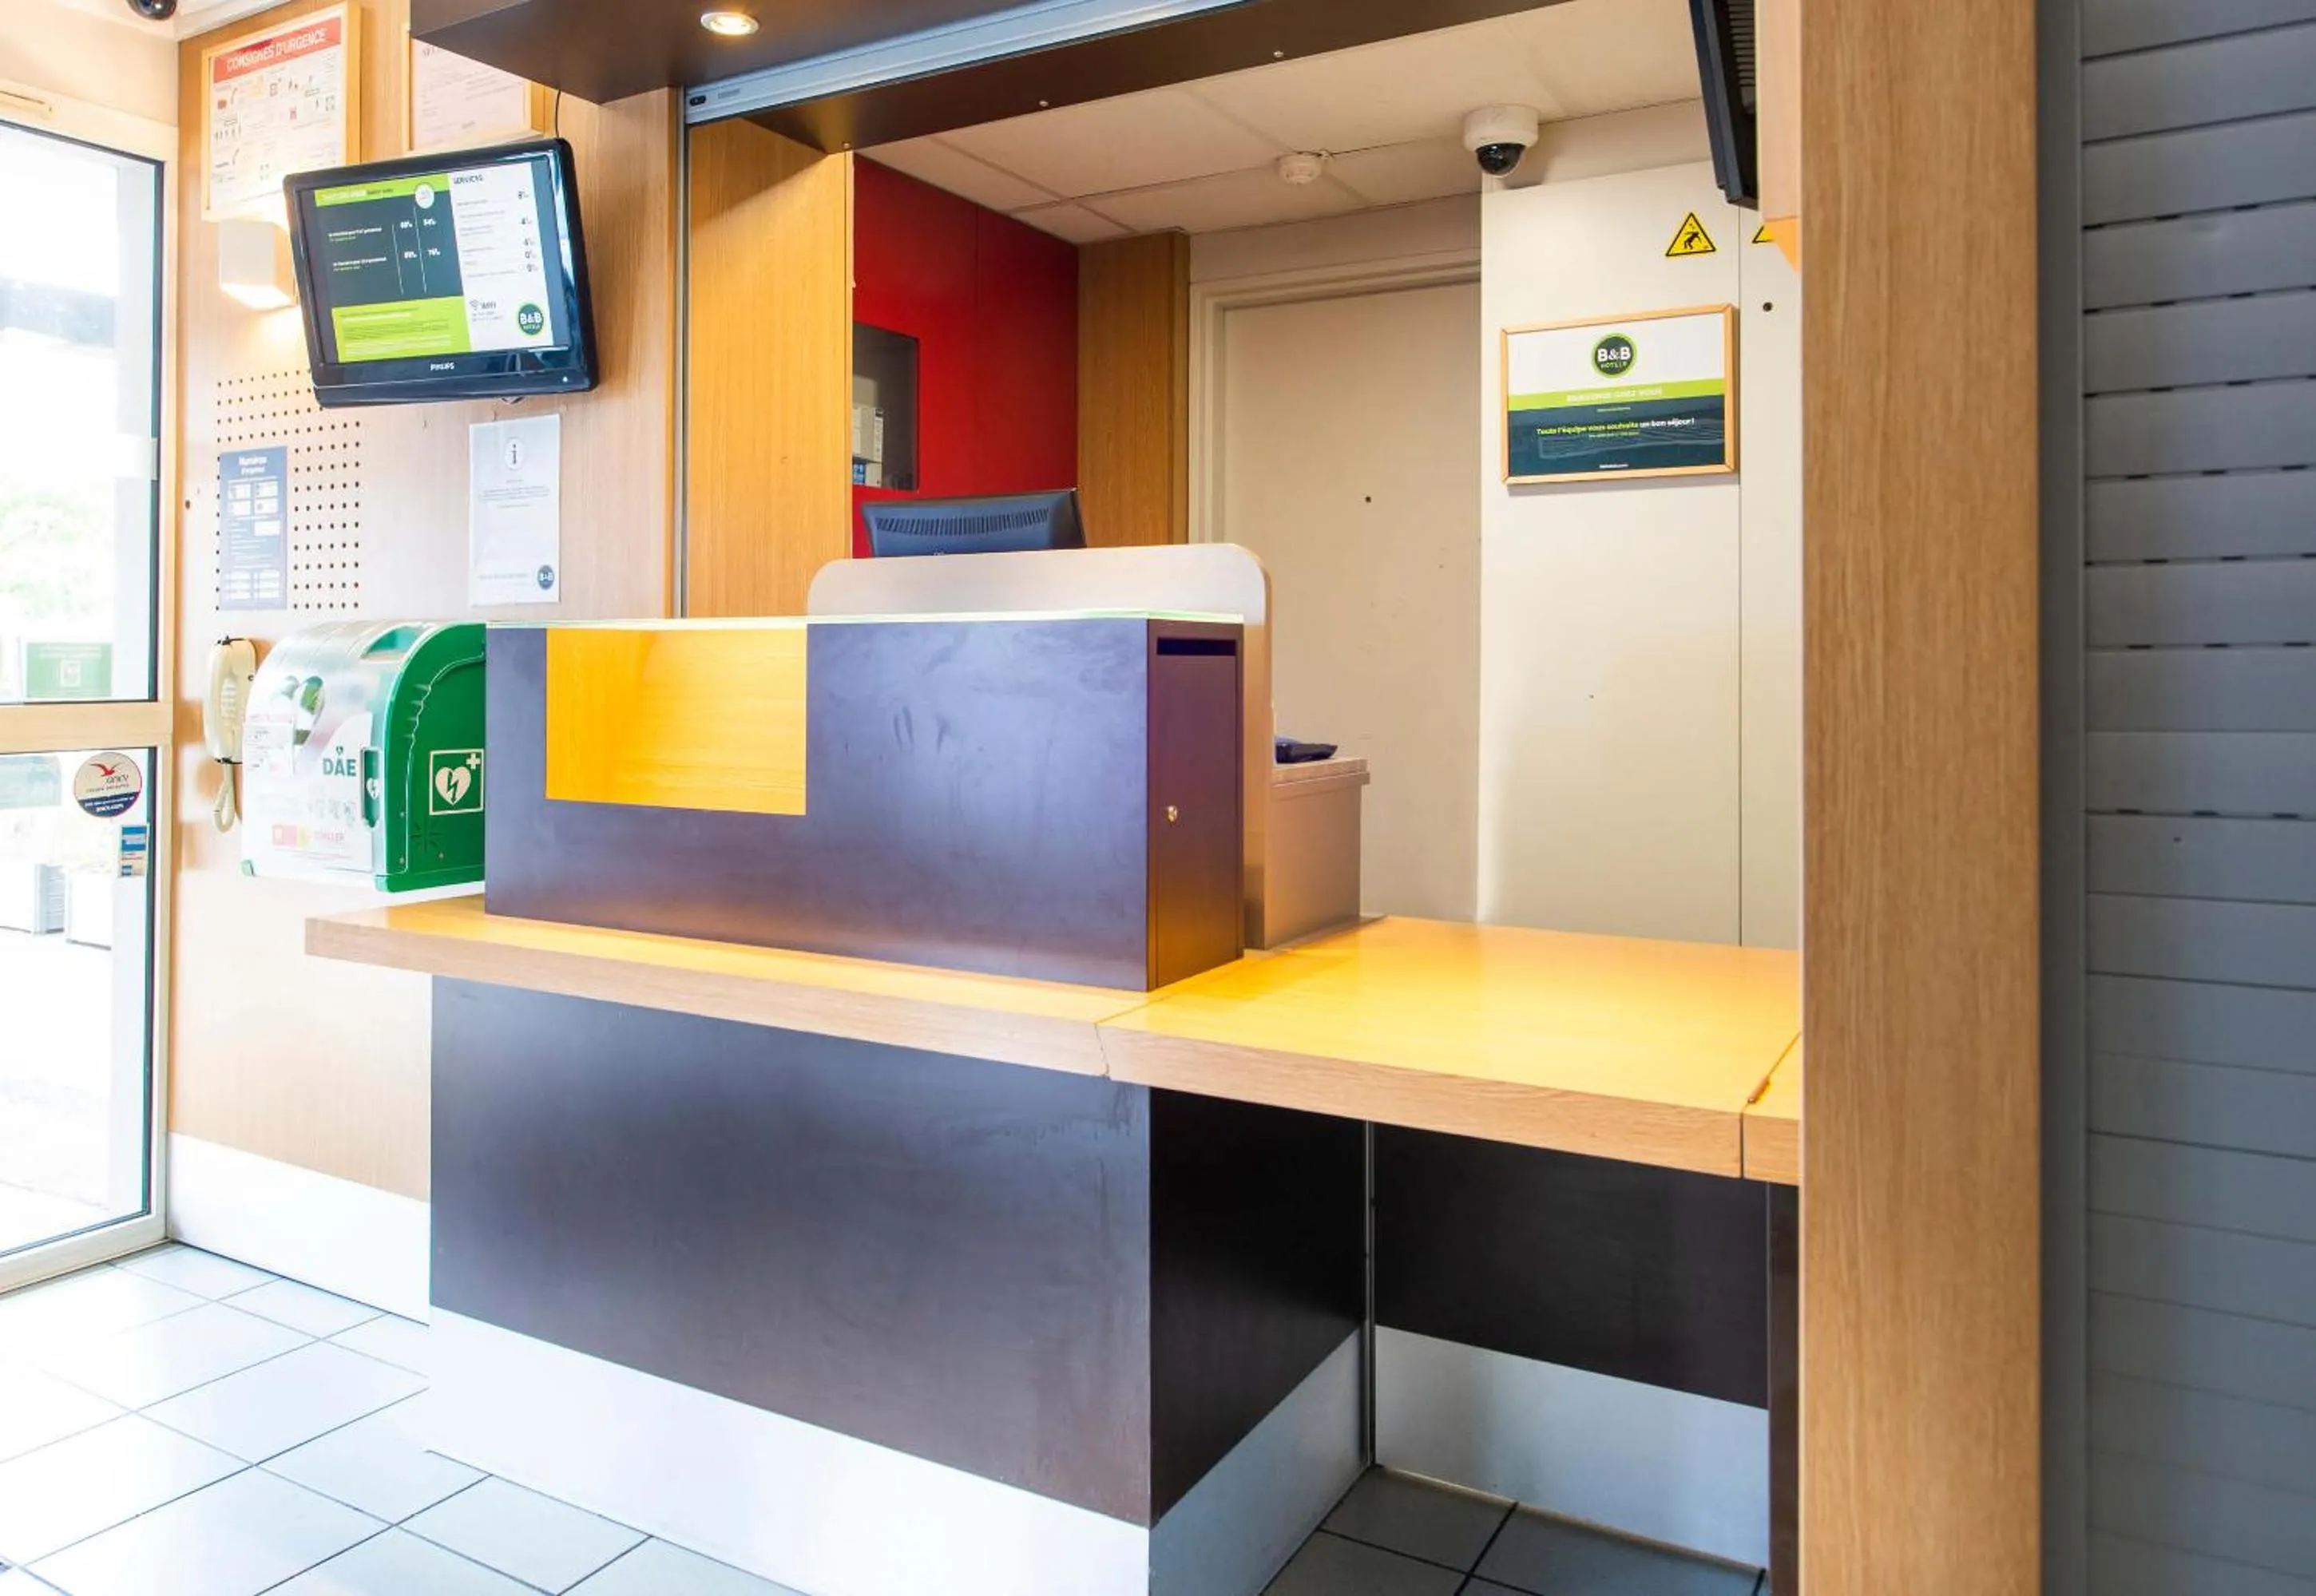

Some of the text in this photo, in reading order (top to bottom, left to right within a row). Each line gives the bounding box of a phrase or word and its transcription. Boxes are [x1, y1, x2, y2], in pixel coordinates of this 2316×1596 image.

[226, 27, 327, 72] CONSIGNES D'URGENCE
[520, 311, 542, 325] B&B
[1597, 347, 1632, 362] B&B
[430, 362, 455, 371] PHILIPS
[1607, 422, 1639, 430] souhaite
[323, 758, 357, 777] DAE
